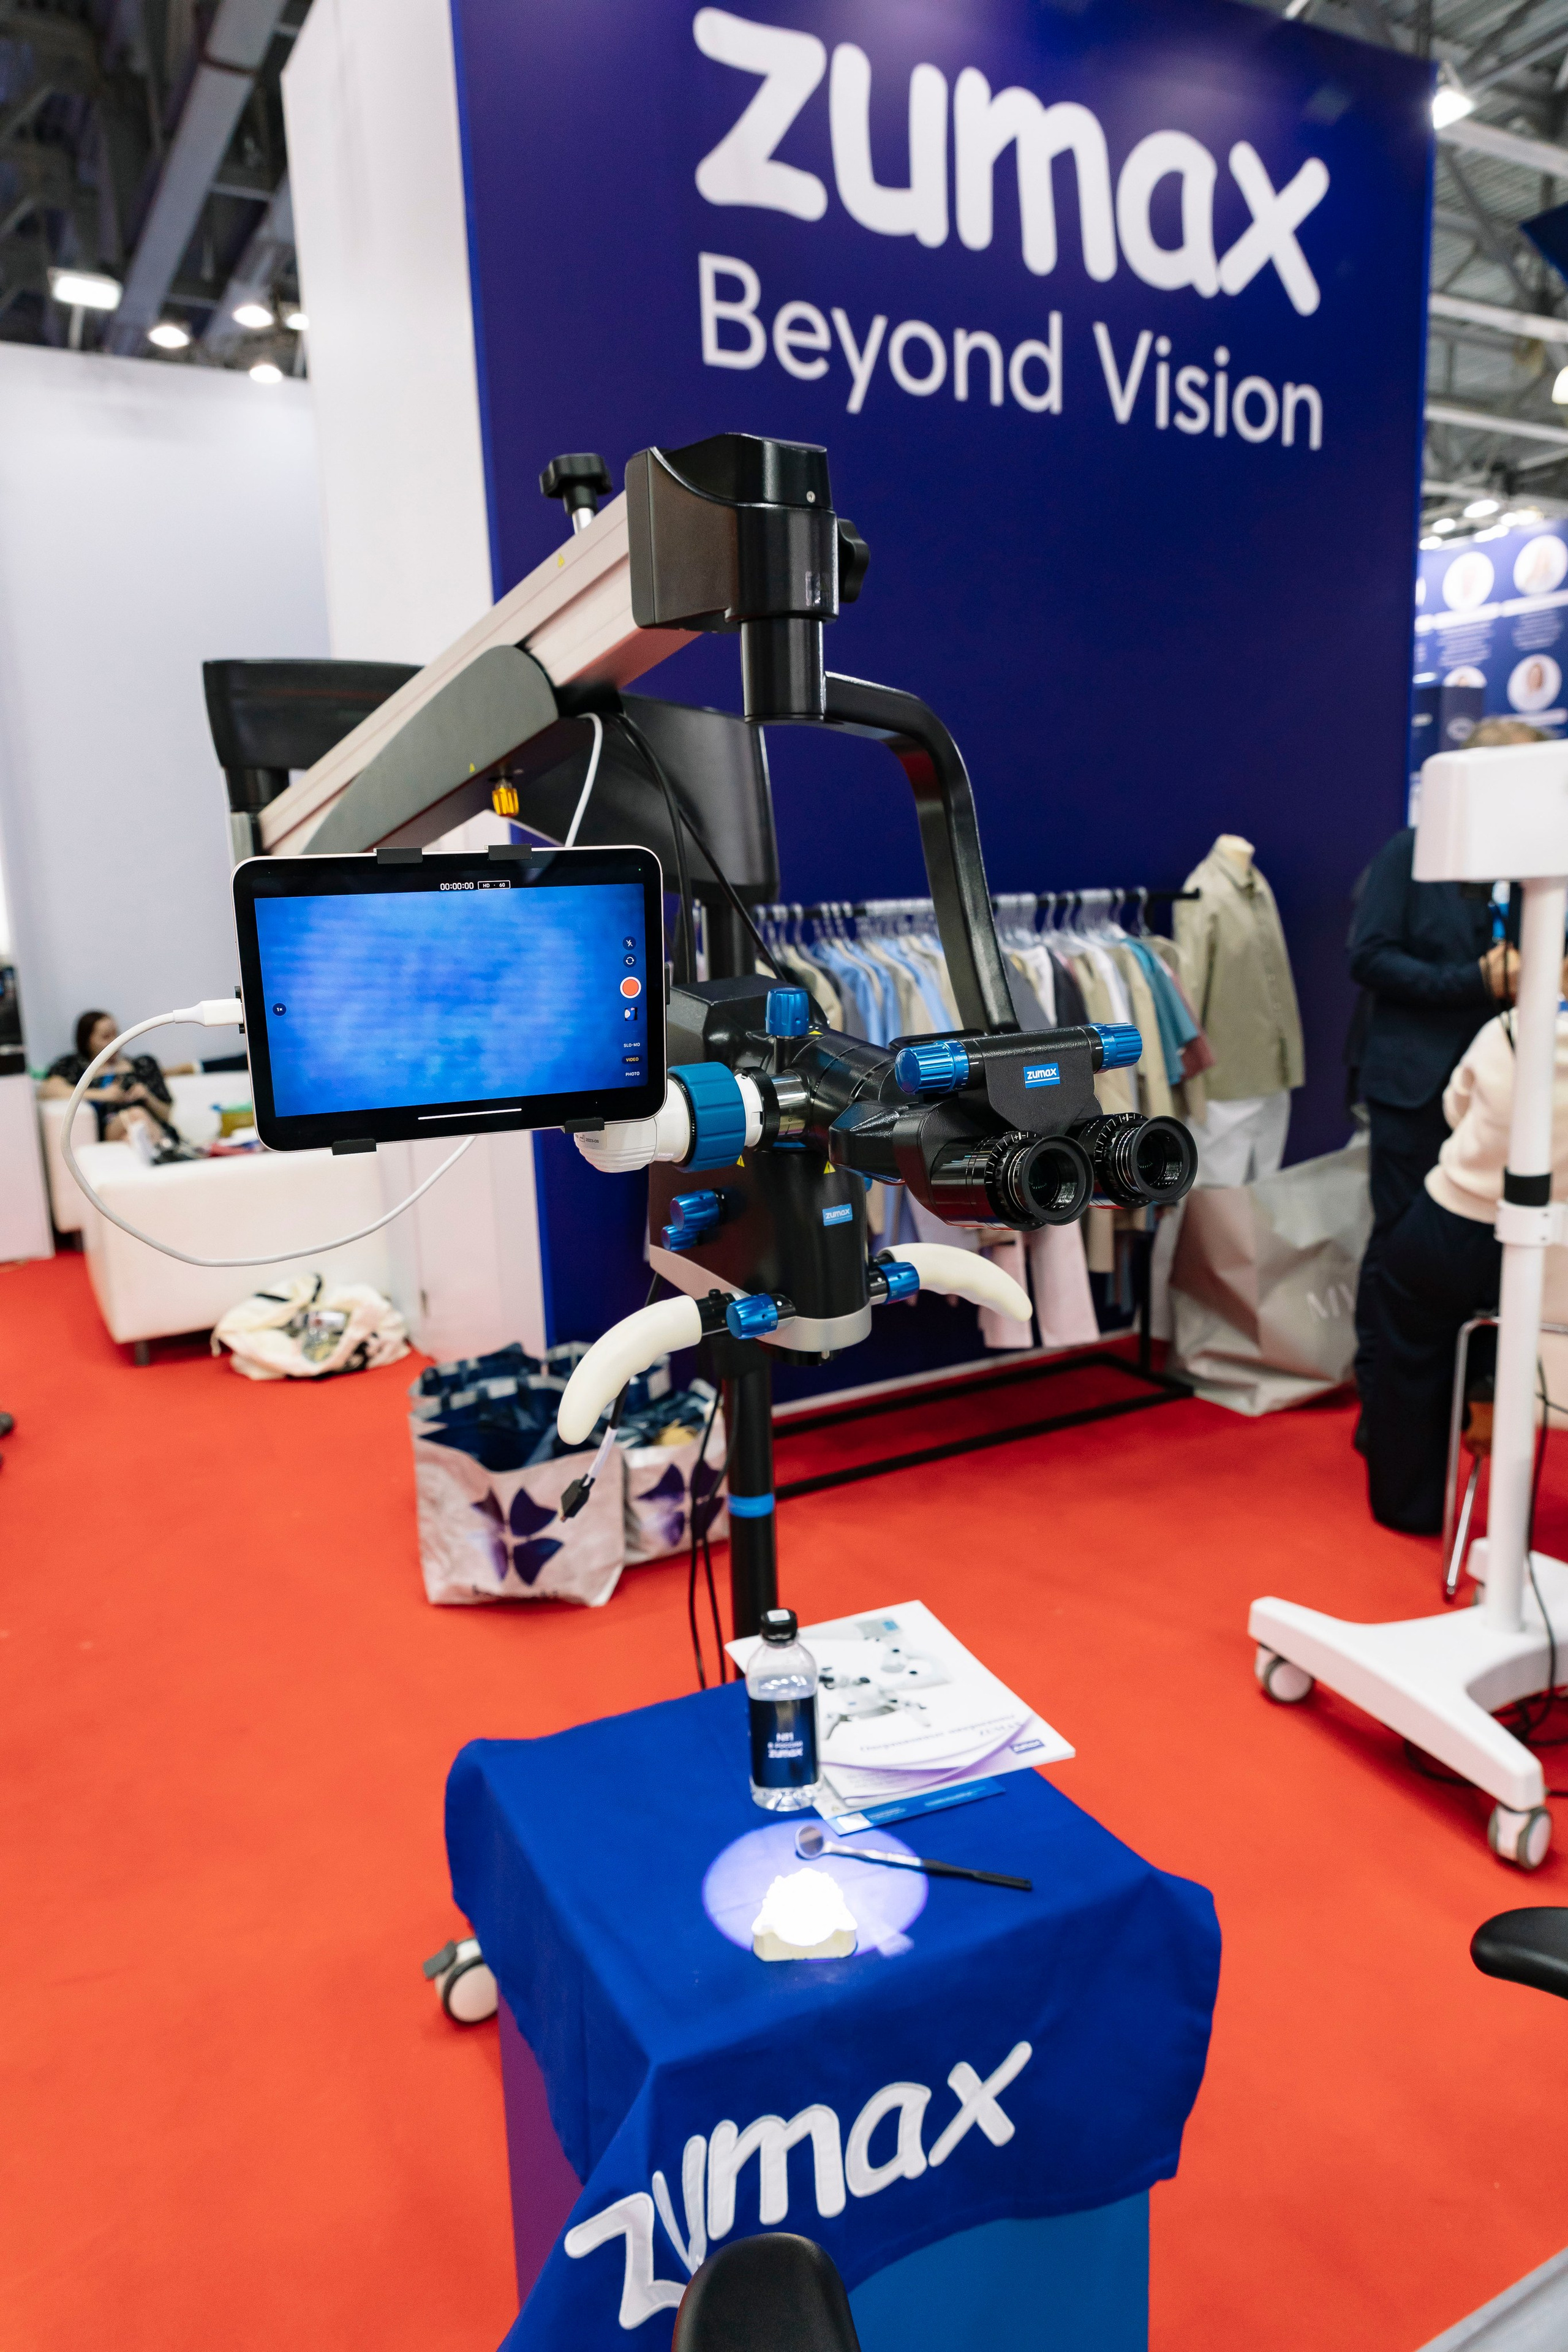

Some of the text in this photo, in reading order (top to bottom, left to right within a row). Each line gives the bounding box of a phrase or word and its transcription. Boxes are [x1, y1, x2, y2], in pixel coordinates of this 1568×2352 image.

[693, 6, 1330, 317] zumax
[698, 251, 1323, 451] Beyond Vision
[1027, 1068, 1057, 1080] zumax
[825, 1208, 850, 1219] zumax
